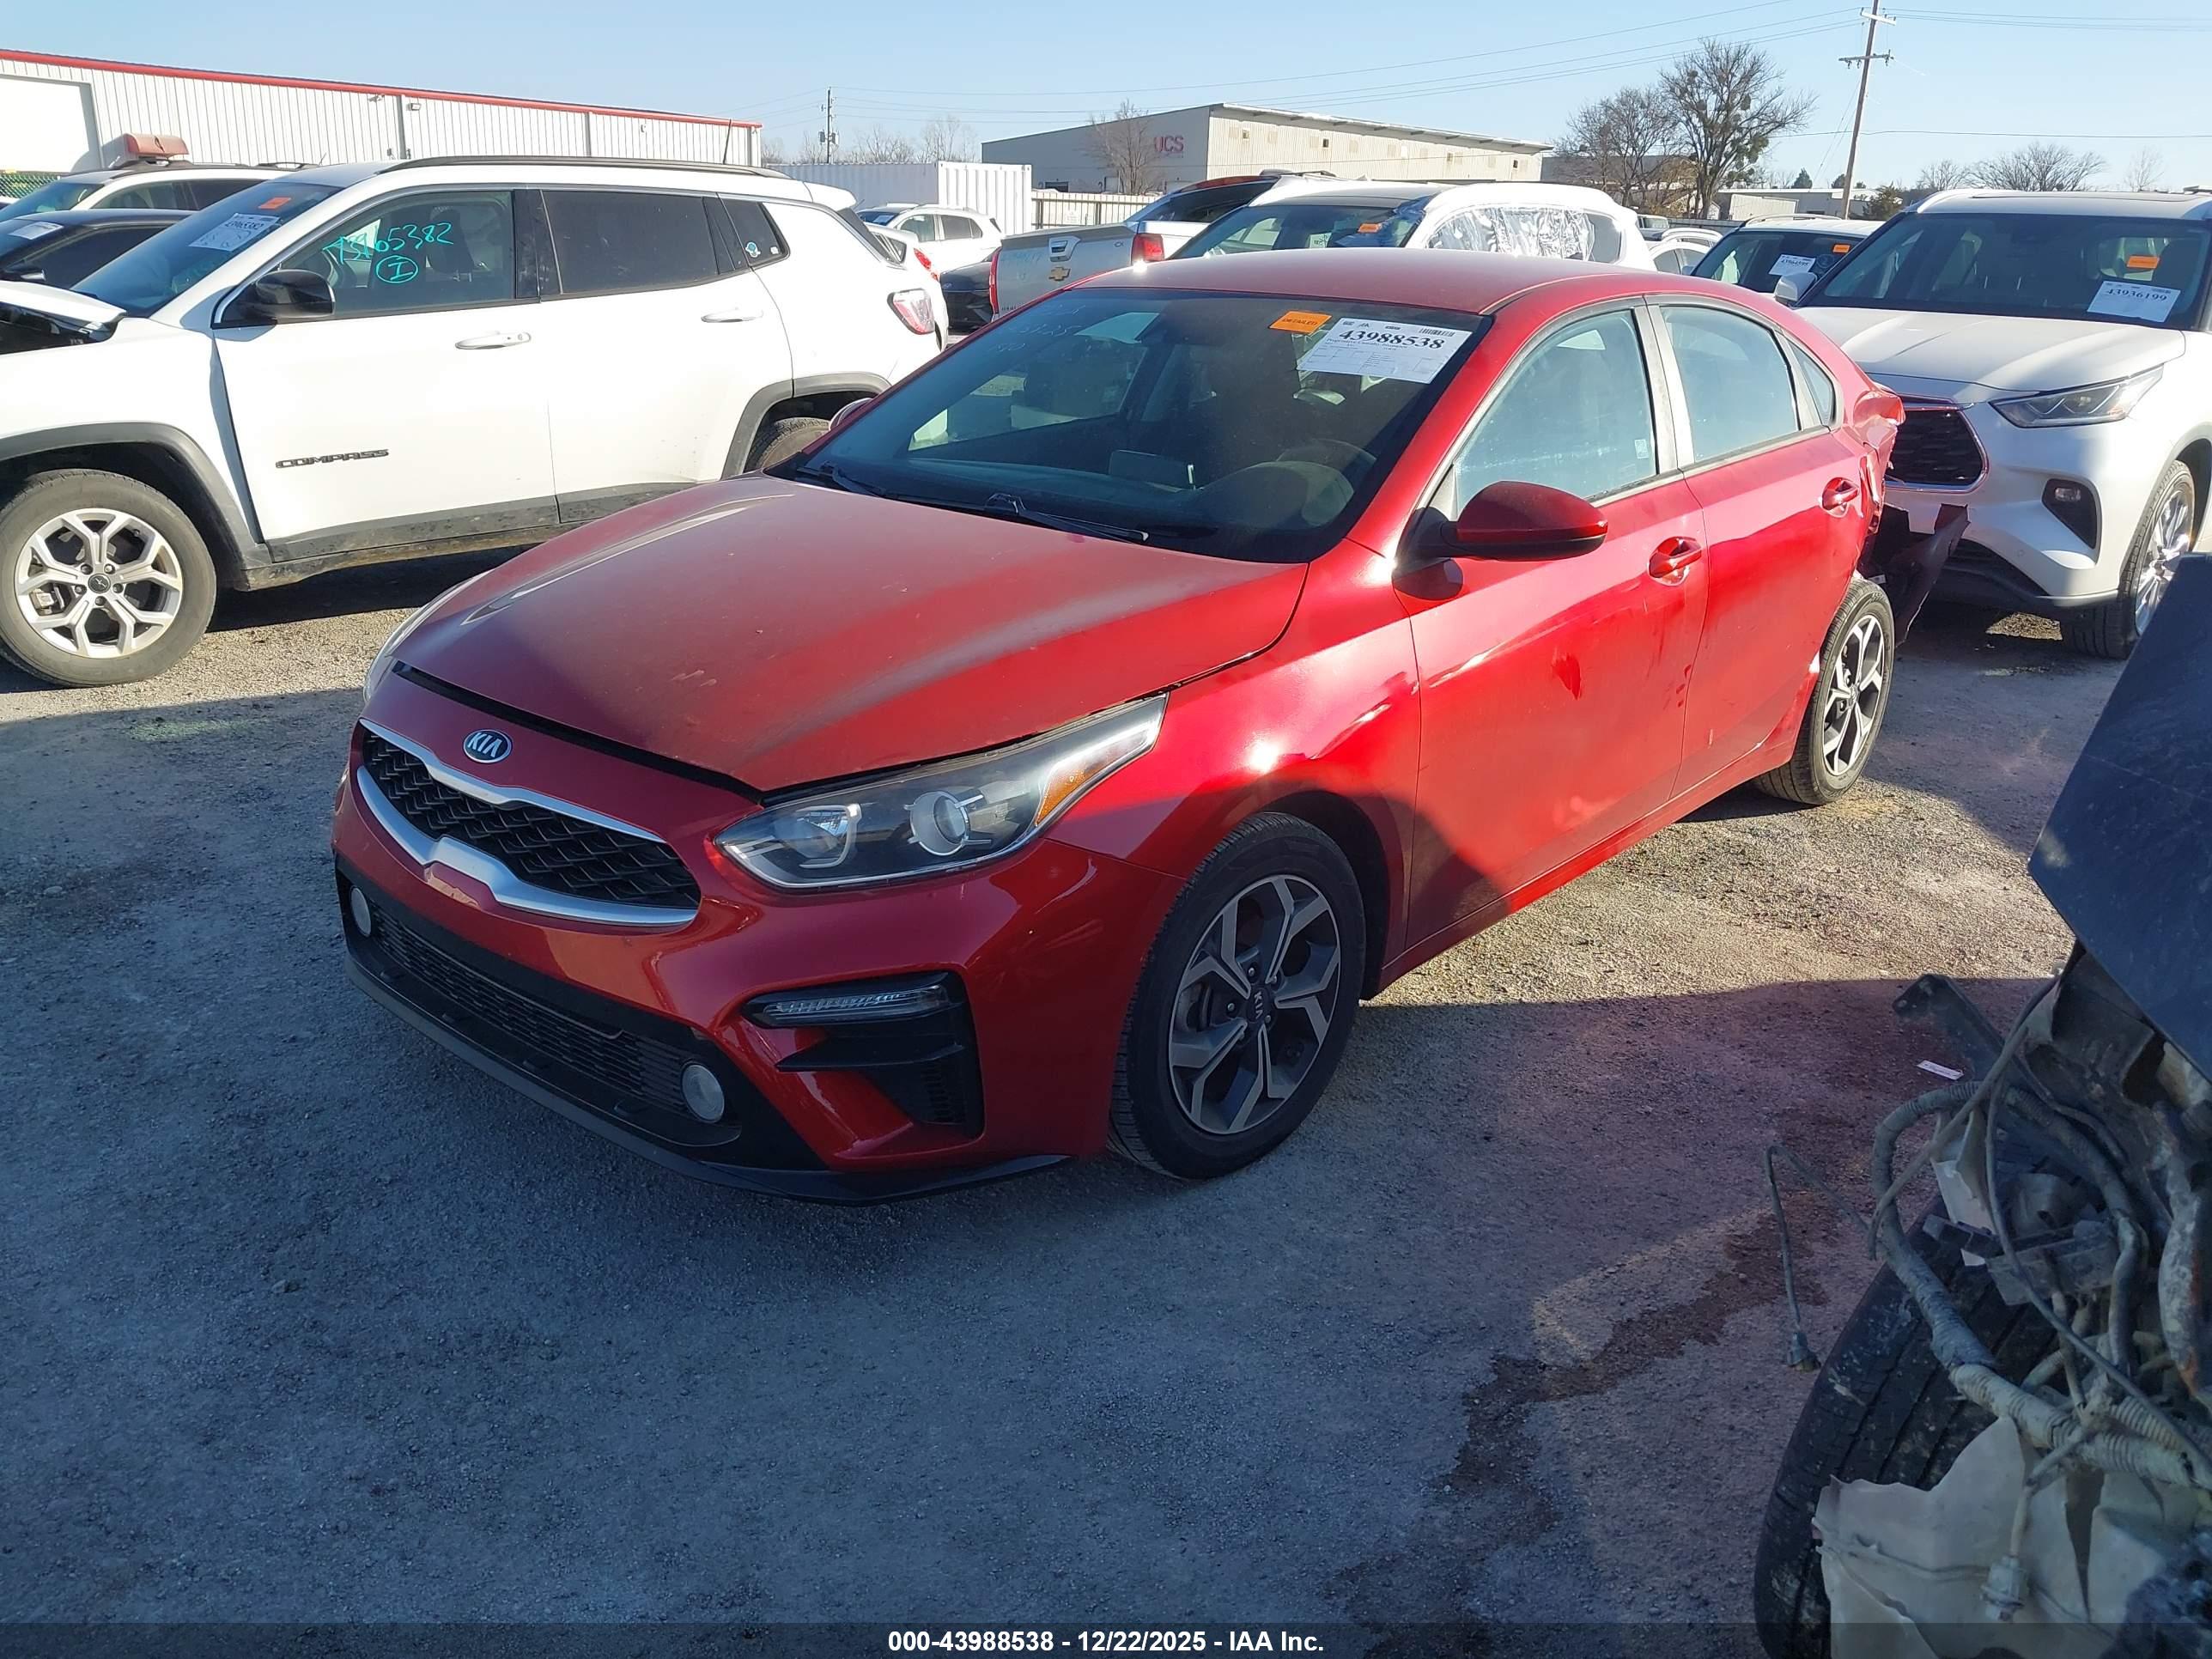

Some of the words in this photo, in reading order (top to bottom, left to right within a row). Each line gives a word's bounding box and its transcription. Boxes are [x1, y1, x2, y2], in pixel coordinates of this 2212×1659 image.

[1154, 136, 1184, 153] UCS
[1281, 318, 1318, 326] DETAILED
[1339, 329, 1445, 350] 43988538
[276, 449, 389, 468] COMPASS
[467, 732, 502, 758] KIA
[1254, 991, 1263, 1019] KIA
